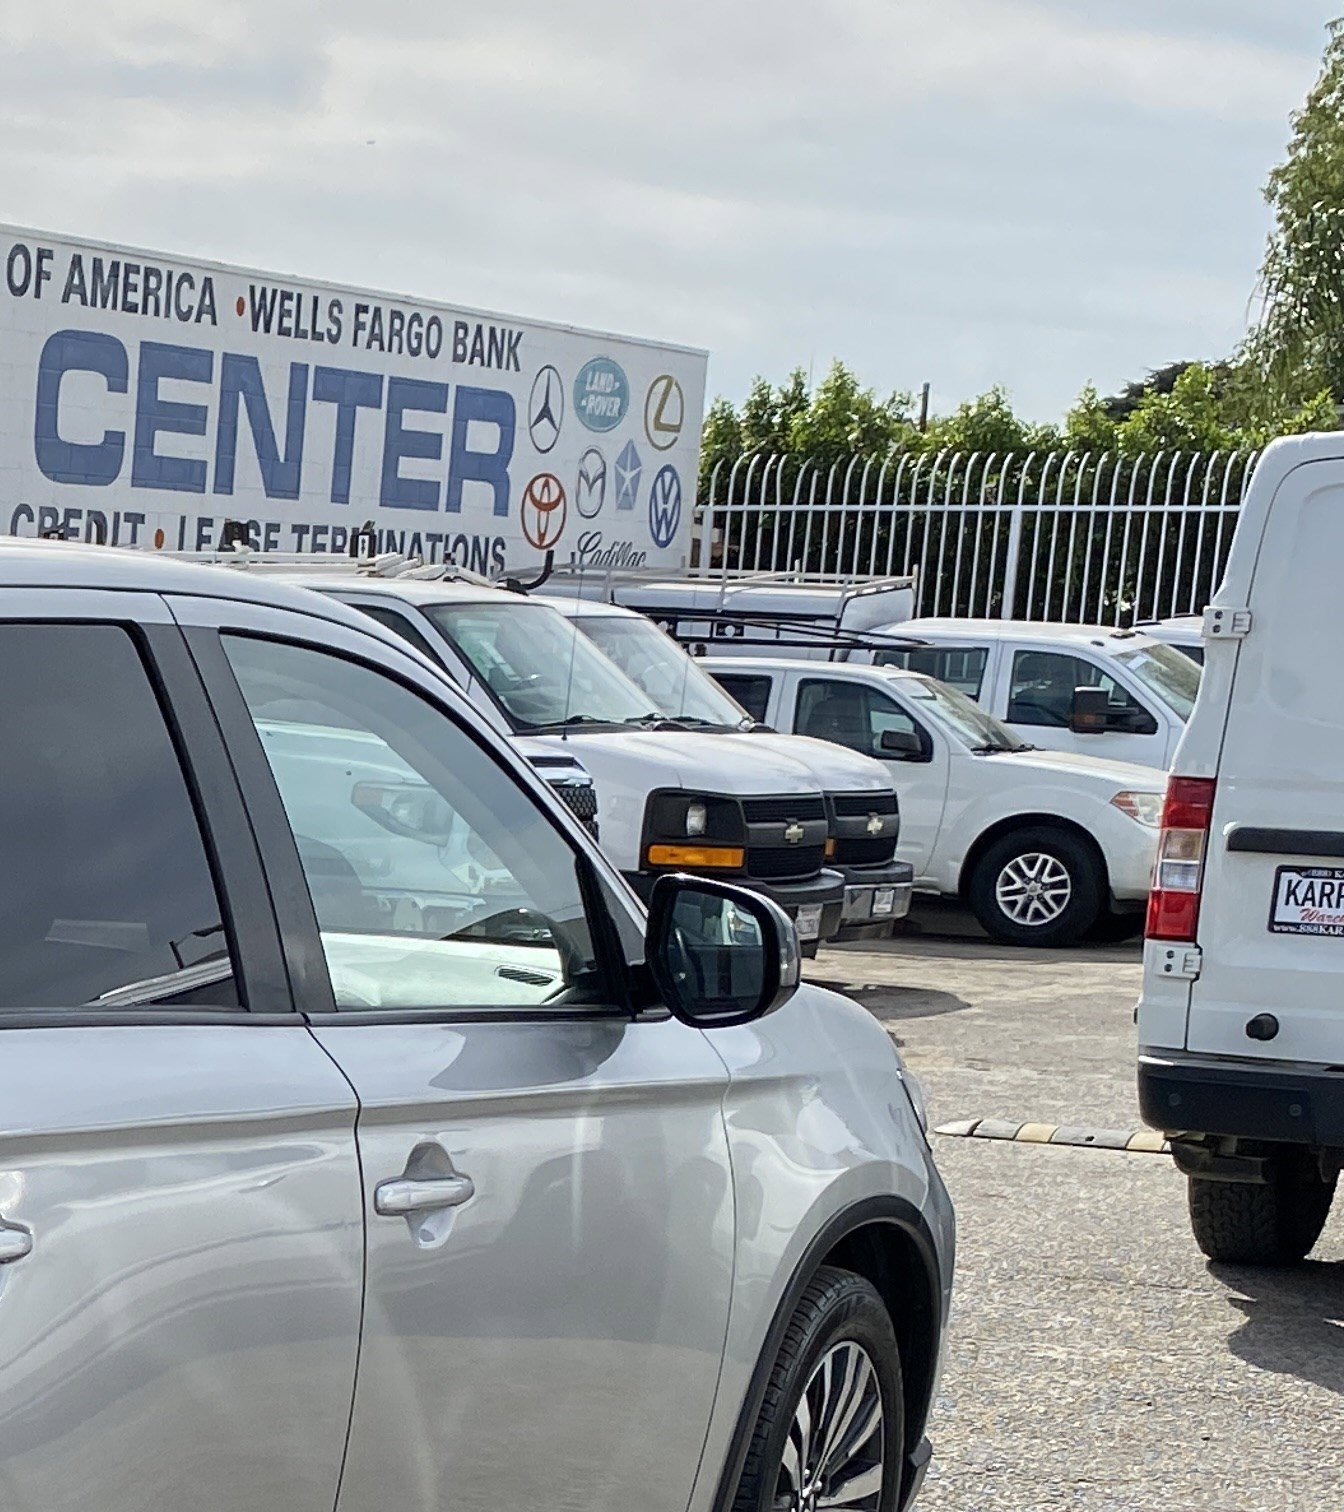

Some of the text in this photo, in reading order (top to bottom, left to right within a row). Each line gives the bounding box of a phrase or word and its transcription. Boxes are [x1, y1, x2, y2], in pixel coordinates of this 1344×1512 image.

[6, 243, 55, 301] OF
[62, 255, 218, 327] AMERICA
[248, 284, 343, 345] WELLS
[353, 303, 443, 361] FARGO
[452, 320, 524, 373] BANK
[585, 371, 615, 392] LAND
[586, 397, 621, 418] ROVER
[33, 329, 518, 518] CENTER
